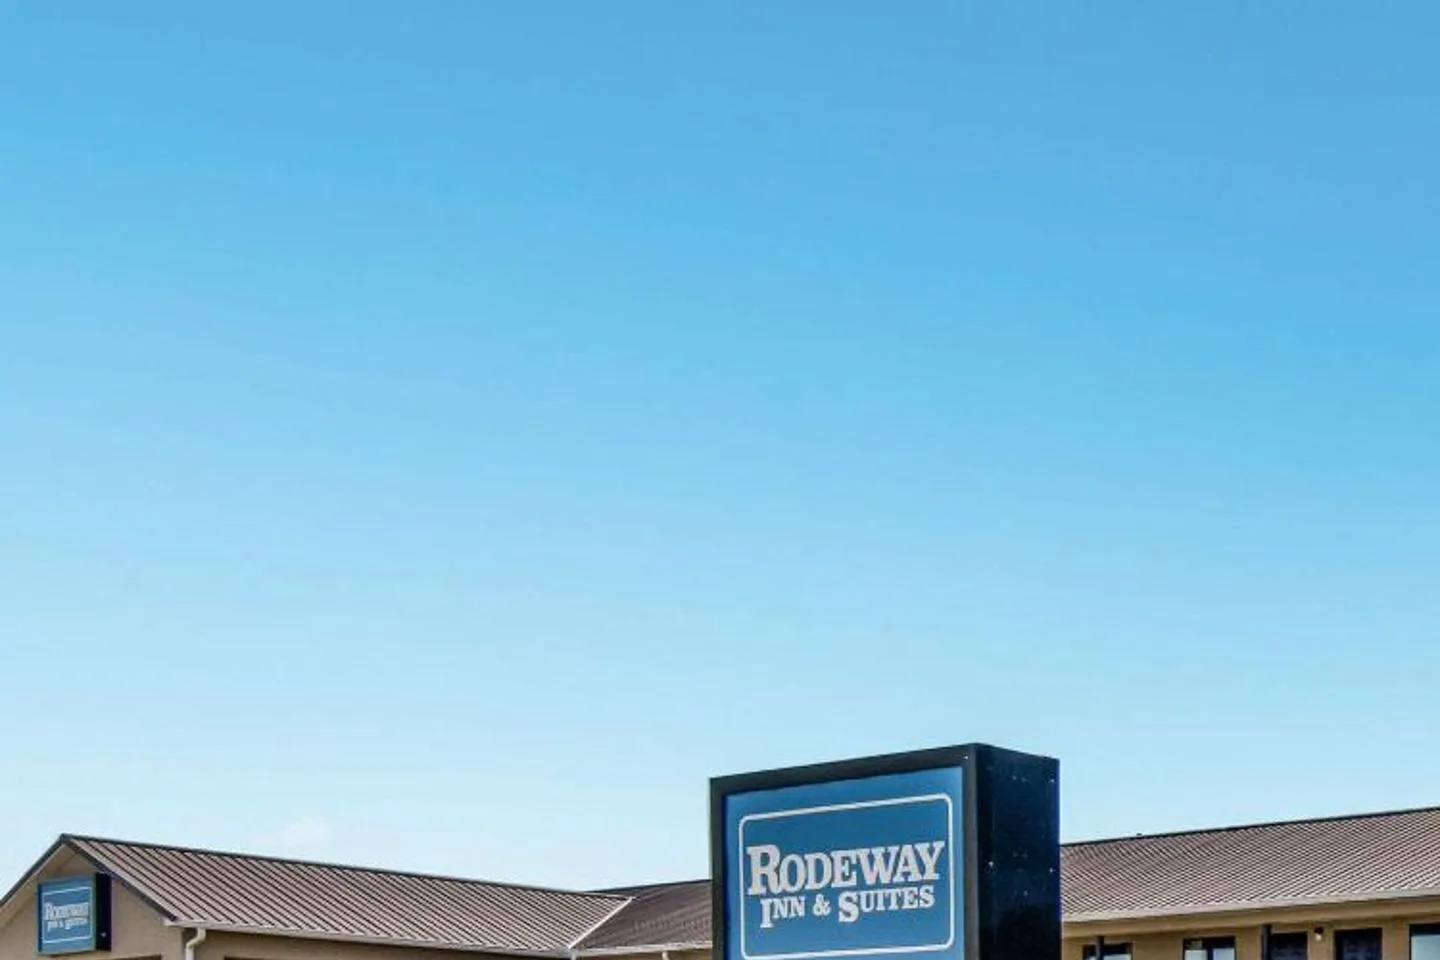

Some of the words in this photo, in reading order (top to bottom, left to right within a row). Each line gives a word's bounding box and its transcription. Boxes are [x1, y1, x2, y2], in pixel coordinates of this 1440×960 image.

[746, 840, 945, 895] RODEWAY
[760, 896, 805, 928] INN
[812, 894, 831, 916] &
[838, 885, 935, 922] SUITES
